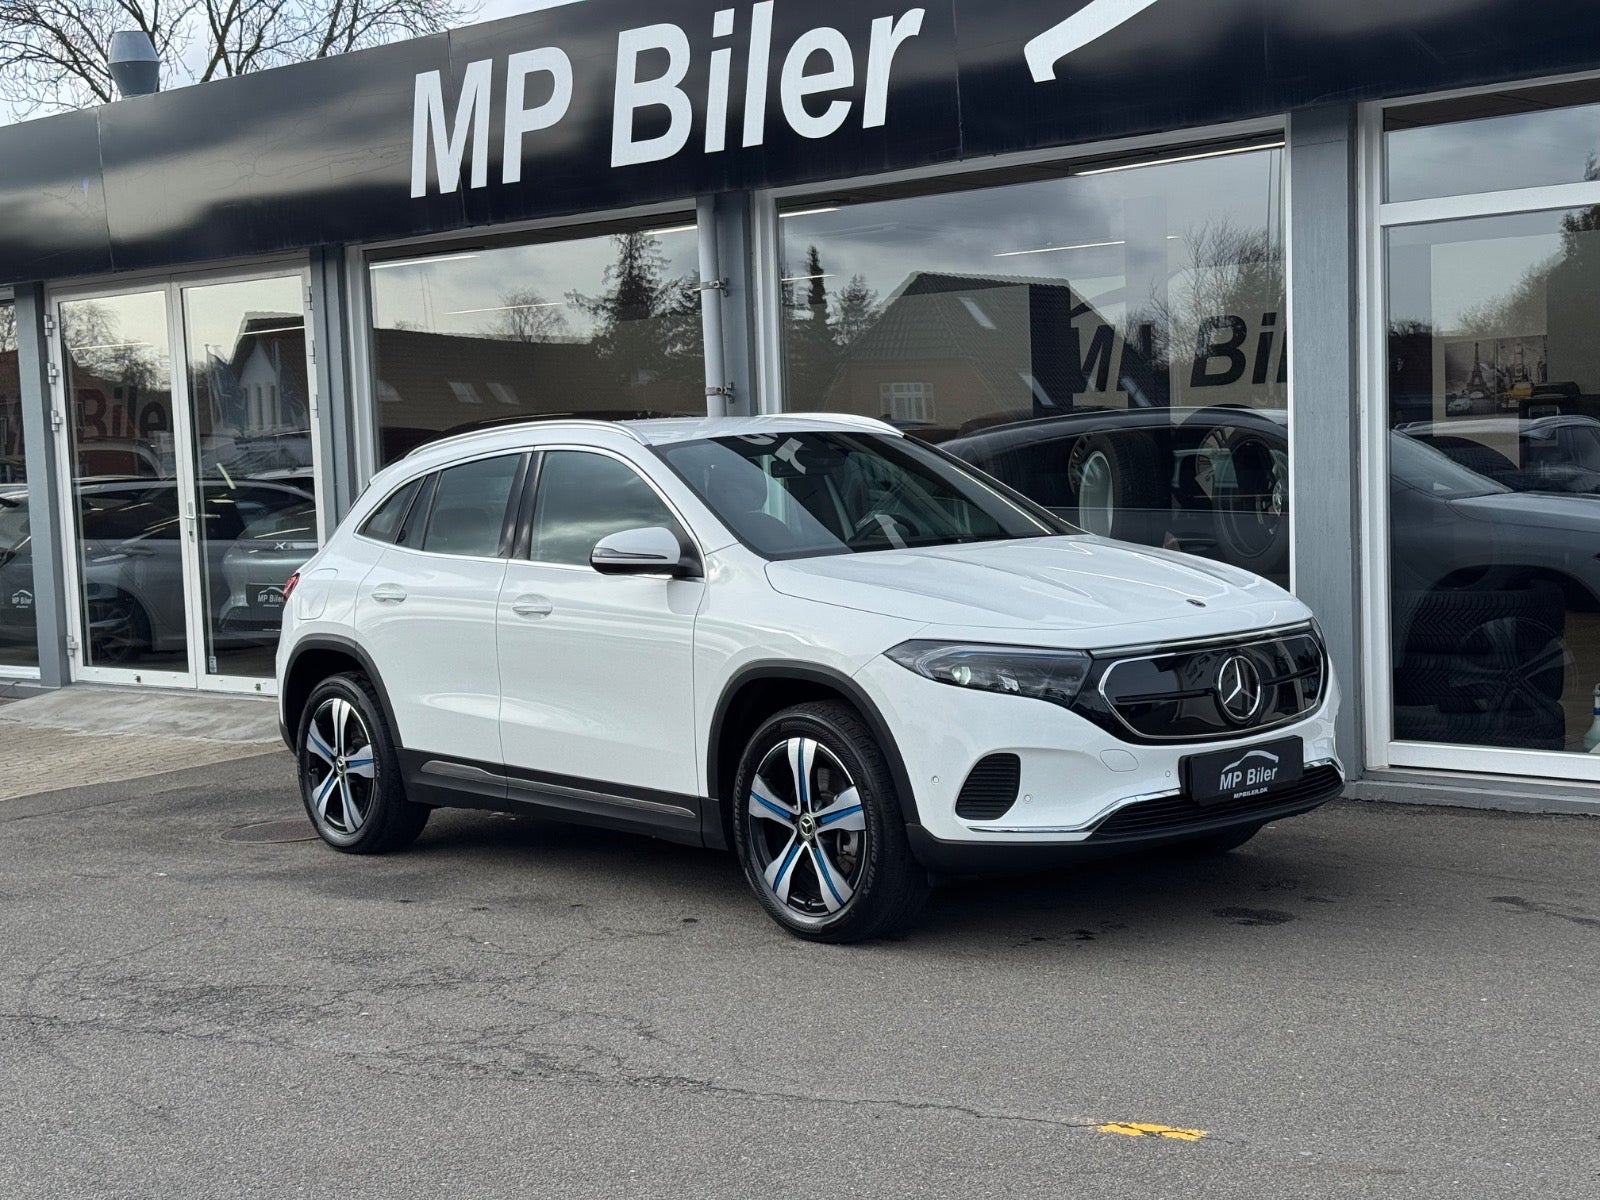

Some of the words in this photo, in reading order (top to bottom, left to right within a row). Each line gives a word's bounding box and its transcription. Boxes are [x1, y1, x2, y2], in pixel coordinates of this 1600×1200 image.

[411, 46, 573, 199] MP
[611, 0, 925, 168] Biler
[1220, 771, 1242, 790] MP
[1246, 766, 1277, 785] Biler
[1233, 787, 1268, 799] MPBILER.DK
